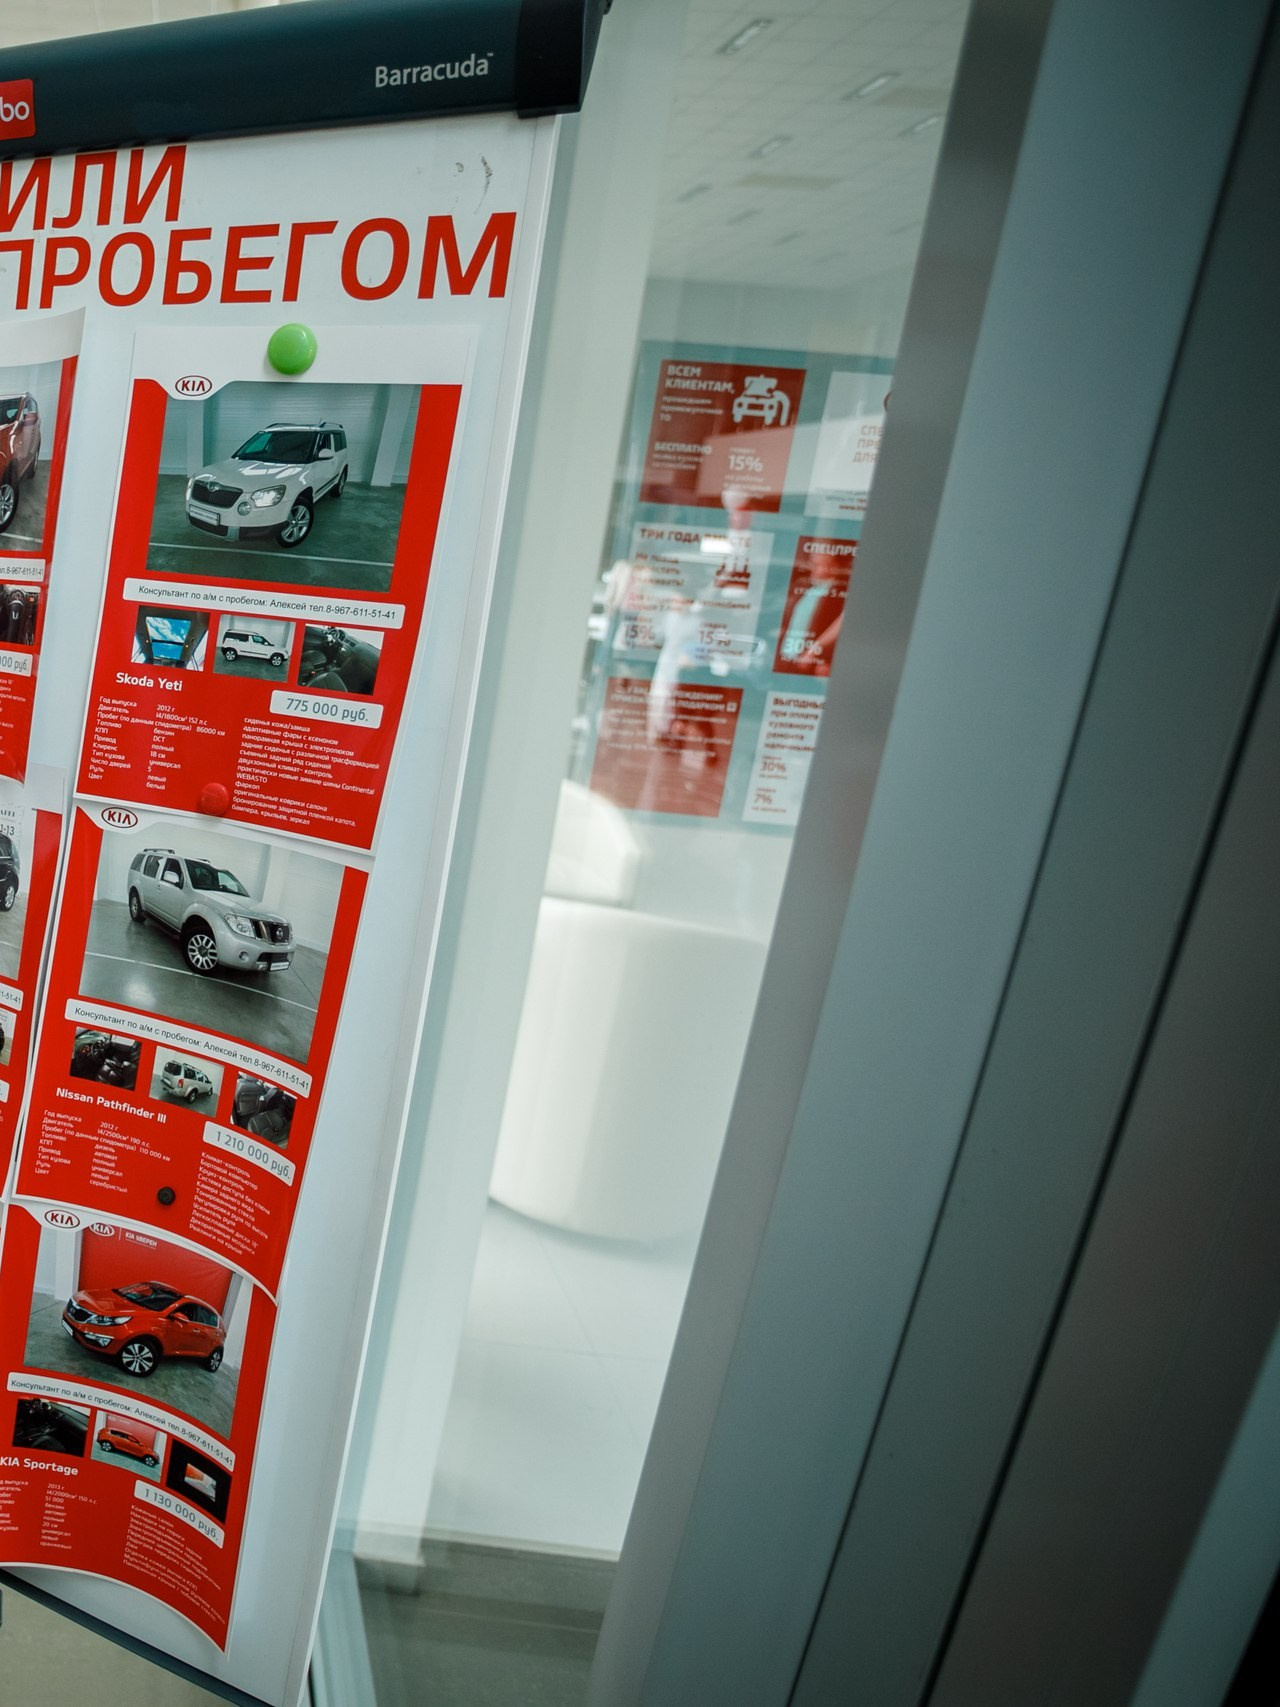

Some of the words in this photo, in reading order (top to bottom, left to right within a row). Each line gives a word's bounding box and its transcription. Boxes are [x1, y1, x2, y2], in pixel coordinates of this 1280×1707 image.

[667, 365, 701, 377] ВСЕМ
[665, 378, 735, 393] КЛИЕНТАМ,
[654, 442, 711, 455] БЕСПЛАТНО
[729, 455, 763, 472] 15%
[640, 529, 664, 540] ТРИ
[668, 530, 699, 543] ГОДА
[139, 586, 188, 602] Консультант
[191, 591, 200, 601] по
[203, 592, 216, 602] а/м
[226, 595, 268, 608] пробегом:
[270, 598, 307, 612] Алексей
[309, 604, 396, 620] тел.8-967-611-51-41
[14, 659, 28, 672] руб.
[116, 673, 154, 689] Skoda
[158, 677, 182, 691] Yeti
[100, 696, 110, 704] Год
[98, 704, 129, 714] Двигатель
[157, 704, 171, 712] 2012
[286, 698, 308, 712] 775
[313, 702, 338, 716] 000
[342, 709, 368, 722] руб.
[97, 720, 122, 728] Топливо
[154, 728, 174, 736] бензин
[94, 735, 116, 744] Привод
[93, 743, 118, 751] Клиренс
[152, 744, 174, 752] полный
[237, 773, 267, 783] WEBASTO
[235, 781, 260, 790] фаркоп
[234, 789, 278, 802] оригинальные
[280, 797, 305, 807] коврики
[307, 802, 327, 811] салона
[75, 1008, 126, 1026] Консультант
[128, 1020, 137, 1030] по
[139, 1022, 153, 1034] а/м
[162, 1027, 202, 1048] пробегом:
[204, 1042, 238, 1060] Алексей
[56, 1088, 93, 1103] Nissan
[97, 1097, 154, 1119] Pathfinder
[157, 1113, 167, 1123] III
[216, 1131, 221, 1142] 1
[225, 1134, 244, 1151] 210
[248, 1146, 269, 1164] 000
[271, 1160, 290, 1179] руб.
[11, 1380, 60, 1394] Консультант
[62, 1388, 71, 1396] по
[73, 1389, 86, 1399] а/м
[94, 1394, 132, 1411] пробегом:
[135, 1407, 166, 1425] Алексей
[0, 1456, 20, 1468] KIA
[24, 1458, 78, 1476] Sportage
[145, 1488, 149, 1498] 1
[153, 1492, 172, 1509] 130
[175, 1502, 196, 1523] 000
[198, 1518, 219, 1541] руб.
